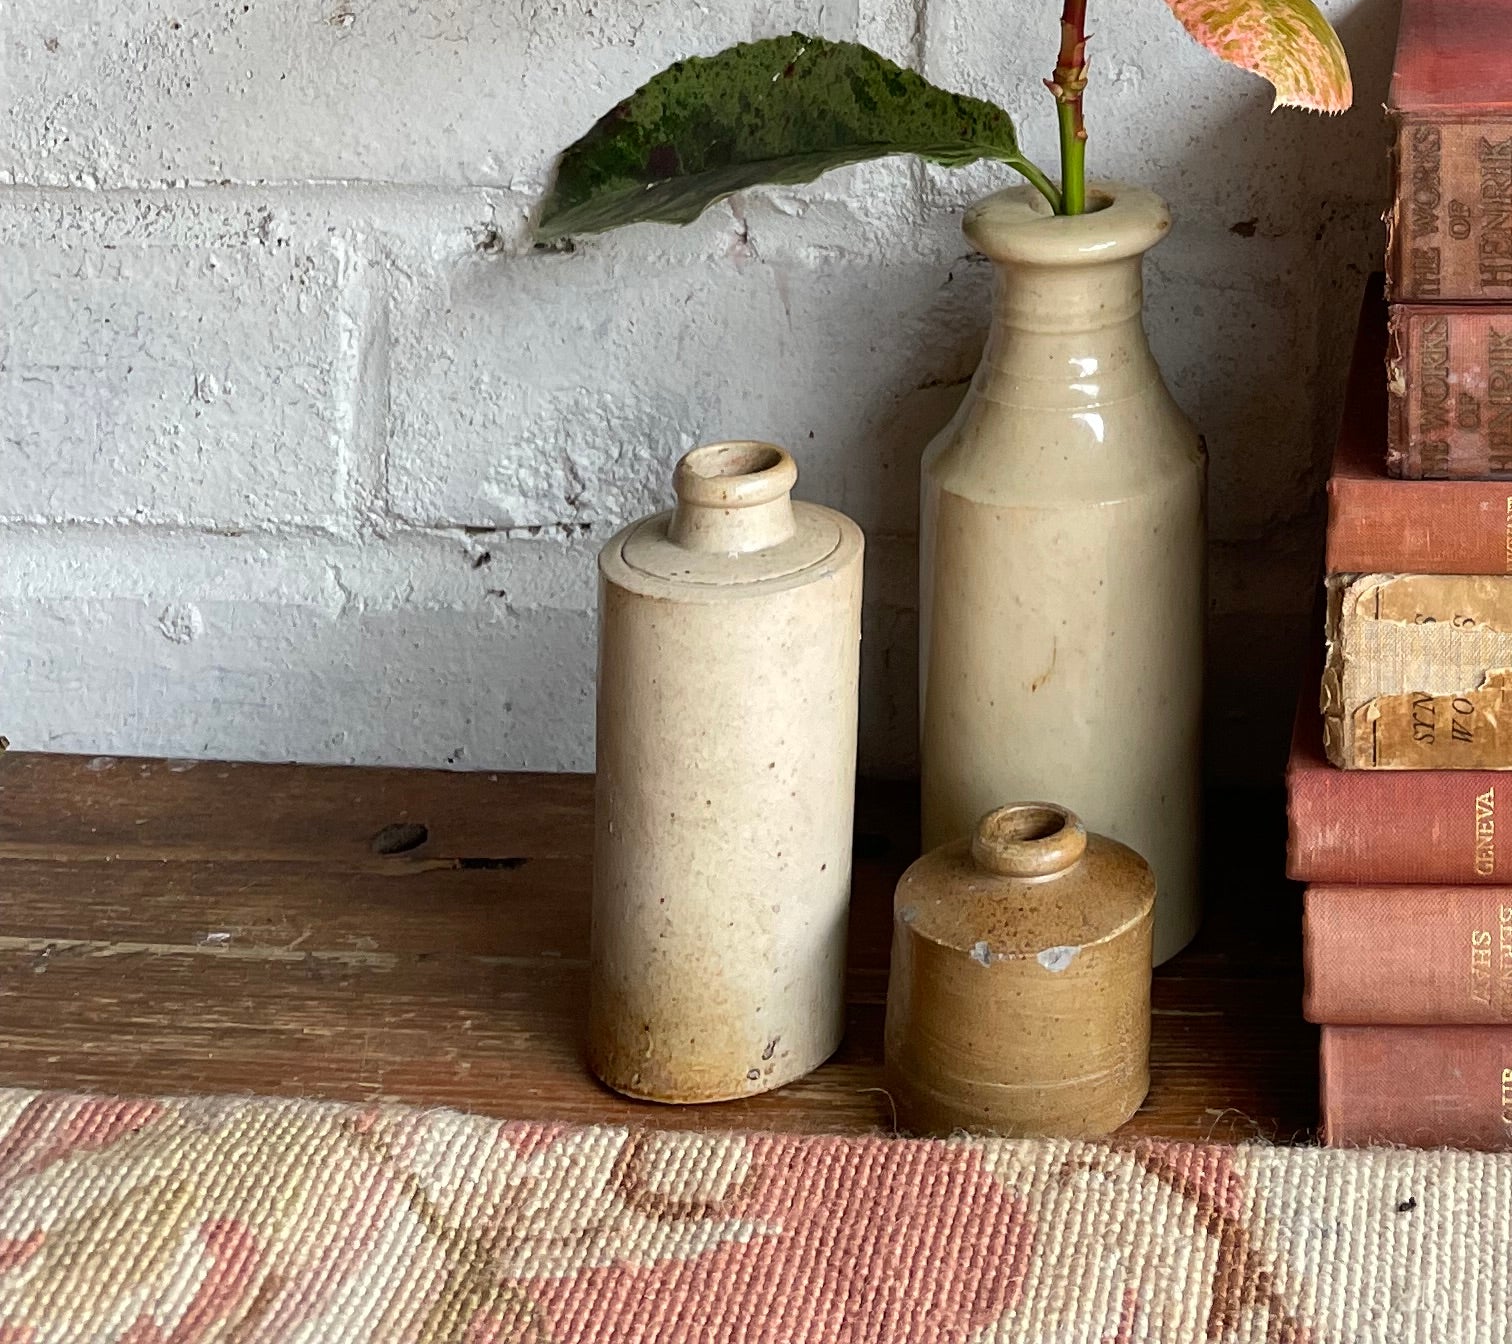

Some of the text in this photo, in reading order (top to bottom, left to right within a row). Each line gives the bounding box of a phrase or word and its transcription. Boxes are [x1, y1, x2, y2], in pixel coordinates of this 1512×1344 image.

[1412, 126, 1441, 296] THE WORKS
[1449, 200, 1470, 240] OF
[1421, 316, 1448, 433] WORKS
[1457, 393, 1480, 432] OF
[1476, 787, 1494, 875] GENEVA
[1472, 930, 1491, 1009] SHAW
